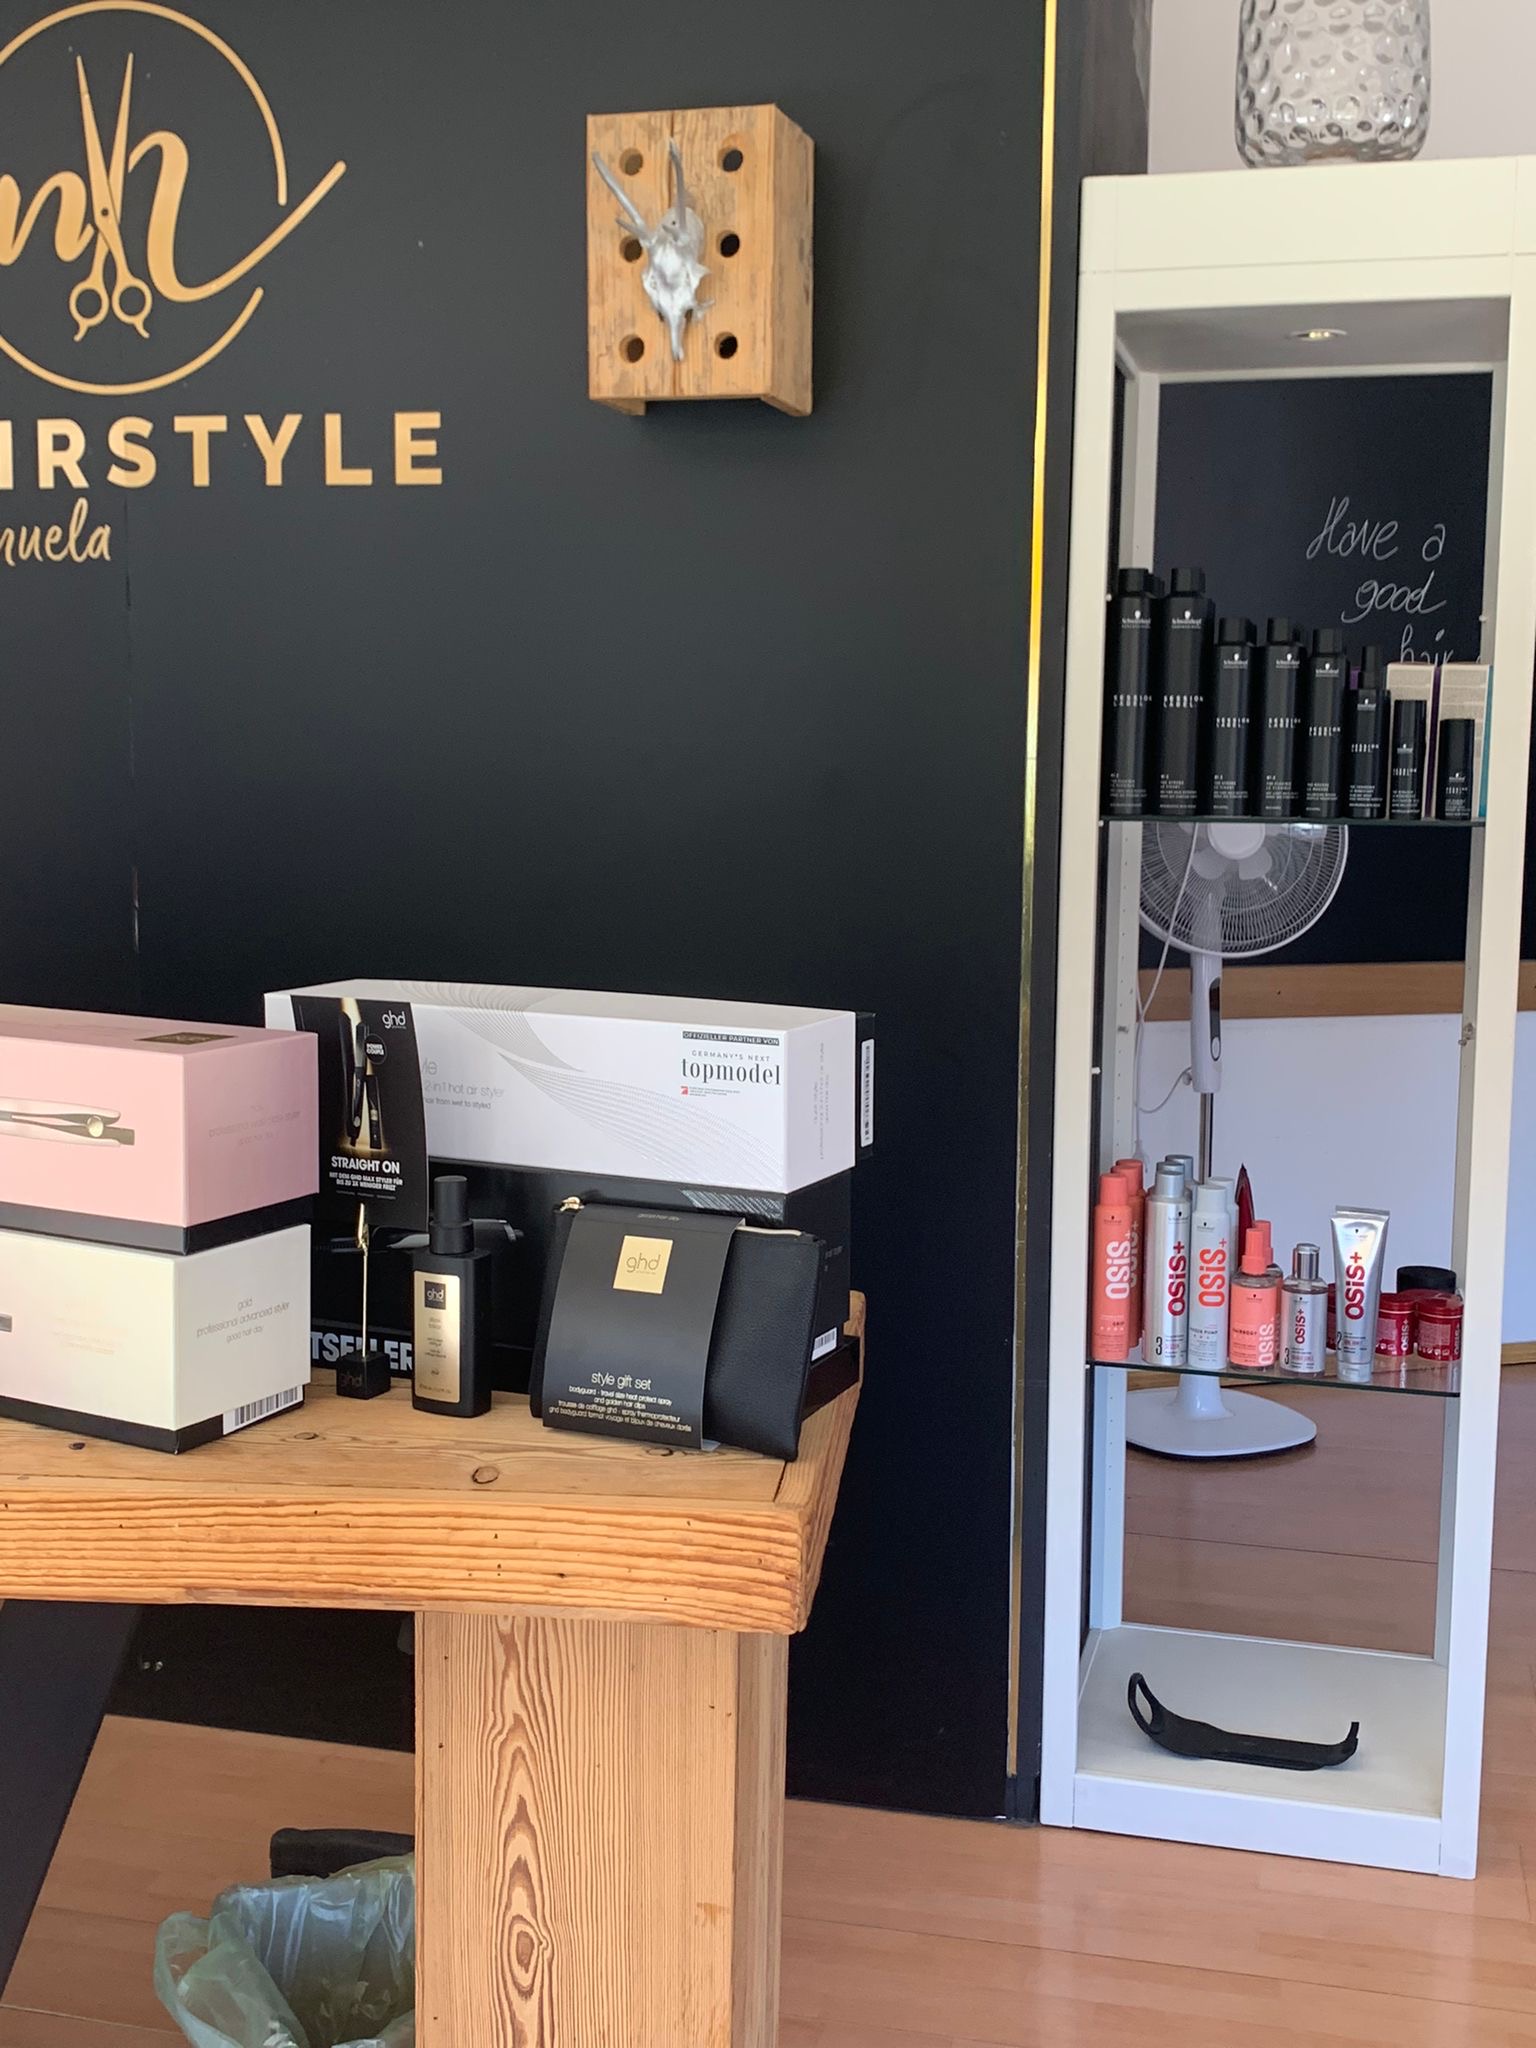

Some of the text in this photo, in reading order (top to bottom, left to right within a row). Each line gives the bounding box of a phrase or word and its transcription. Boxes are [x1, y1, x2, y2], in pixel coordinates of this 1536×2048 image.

[1306, 495, 1446, 562] Have a
[1340, 569, 1446, 624] good
[382, 1010, 406, 1029] ghd
[683, 1031, 779, 1045] OFFIZIELLER PARTNER VON
[681, 1058, 780, 1085] topmodel
[448, 1082, 464, 1094] hot
[331, 1156, 400, 1174] STRAIGHT ON
[626, 1252, 661, 1273] ghd
[427, 1288, 444, 1301] ghd
[196, 1318, 238, 1338] professional
[239, 1307, 273, 1324] advanced
[1155, 1336, 1163, 1355] 3
[1336, 1331, 1342, 1351] 2
[1284, 1347, 1290, 1365] 3
[591, 1372, 651, 1390] style gift set
[568, 1385, 597, 1396] bodyguard
[626, 1392, 638, 1400] heat
[657, 1397, 672, 1406] spray
[623, 1400, 633, 1408] hair
[621, 1408, 637, 1417] spray
